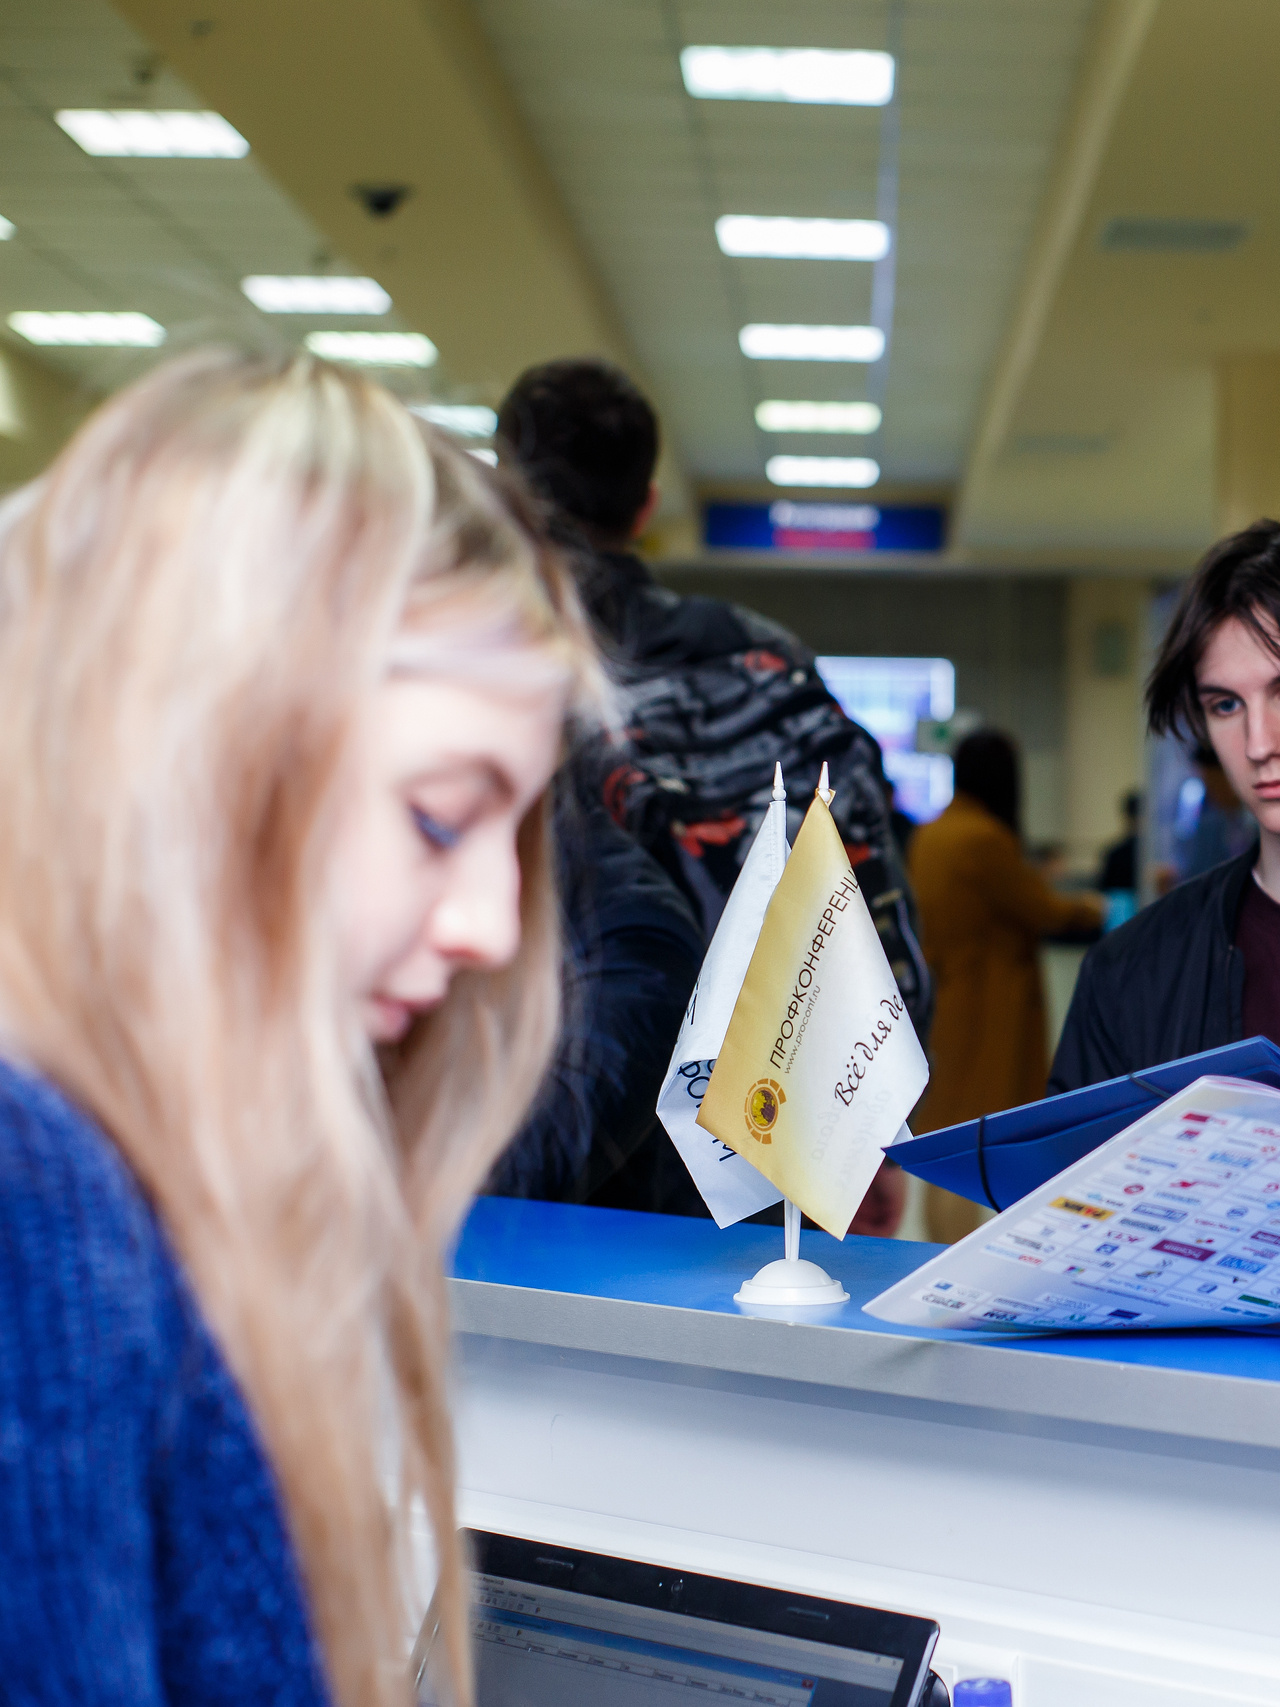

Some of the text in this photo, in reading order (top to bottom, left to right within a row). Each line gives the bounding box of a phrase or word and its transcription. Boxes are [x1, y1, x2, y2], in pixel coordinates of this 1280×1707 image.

[784, 985, 821, 1074] www.proconf.ru
[834, 1055, 866, 1107] Всё
[854, 1020, 892, 1062] для
